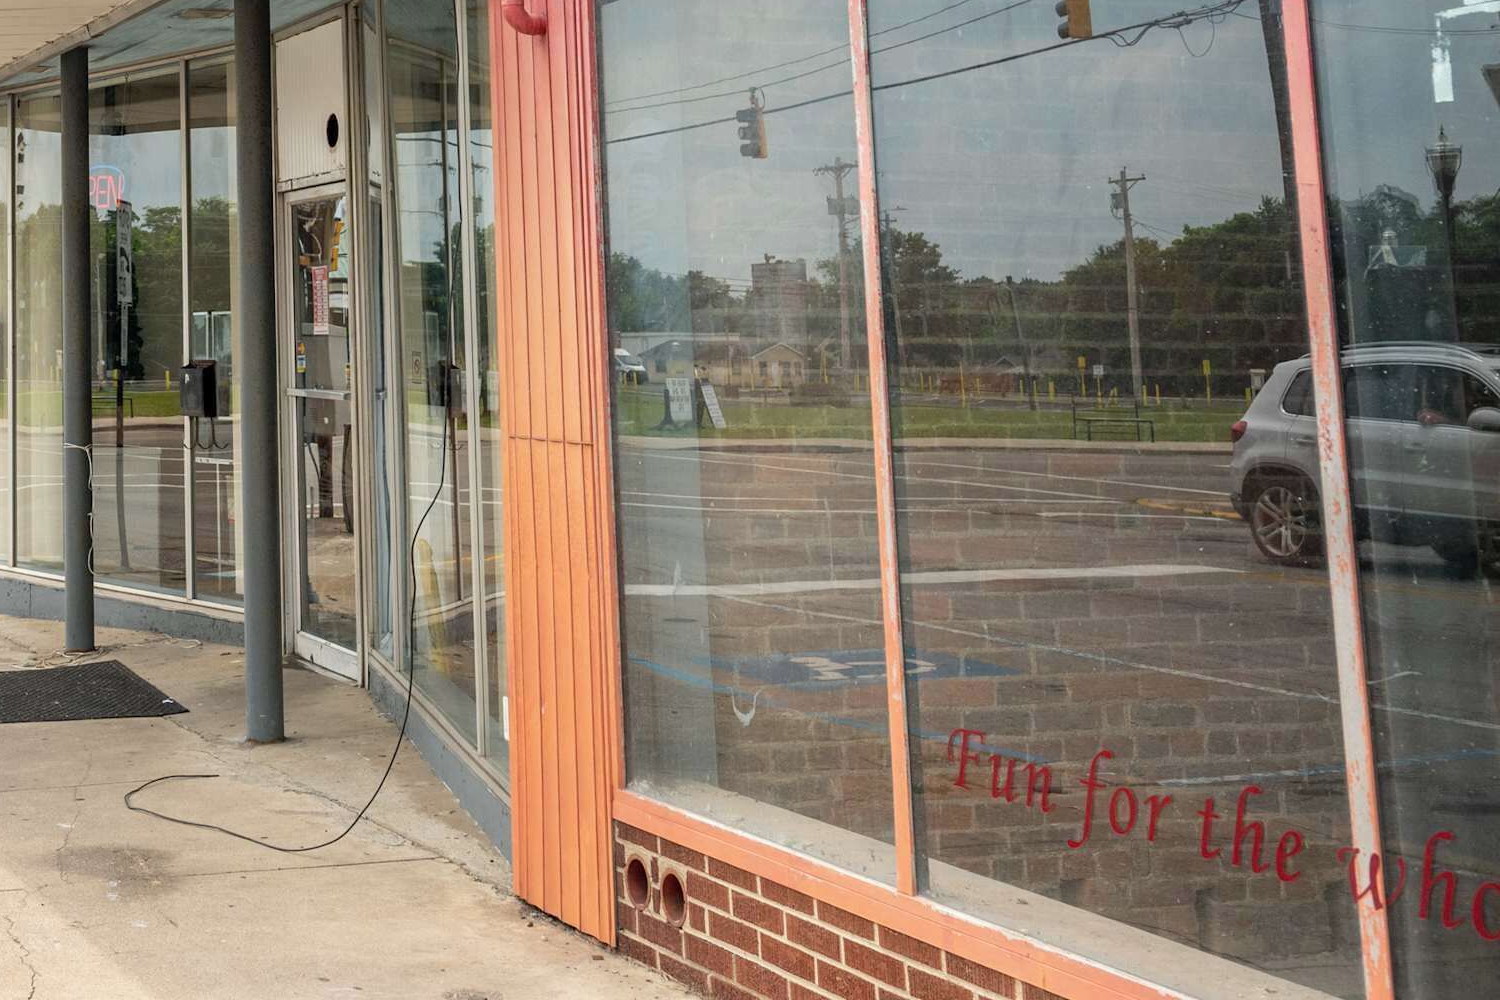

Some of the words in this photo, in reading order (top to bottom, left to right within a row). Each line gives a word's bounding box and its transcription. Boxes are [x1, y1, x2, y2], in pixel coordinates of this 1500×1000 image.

[89, 174, 122, 209] PEN
[947, 728, 1057, 814] Fun
[1067, 750, 1171, 849] for
[1198, 785, 1305, 882] the
